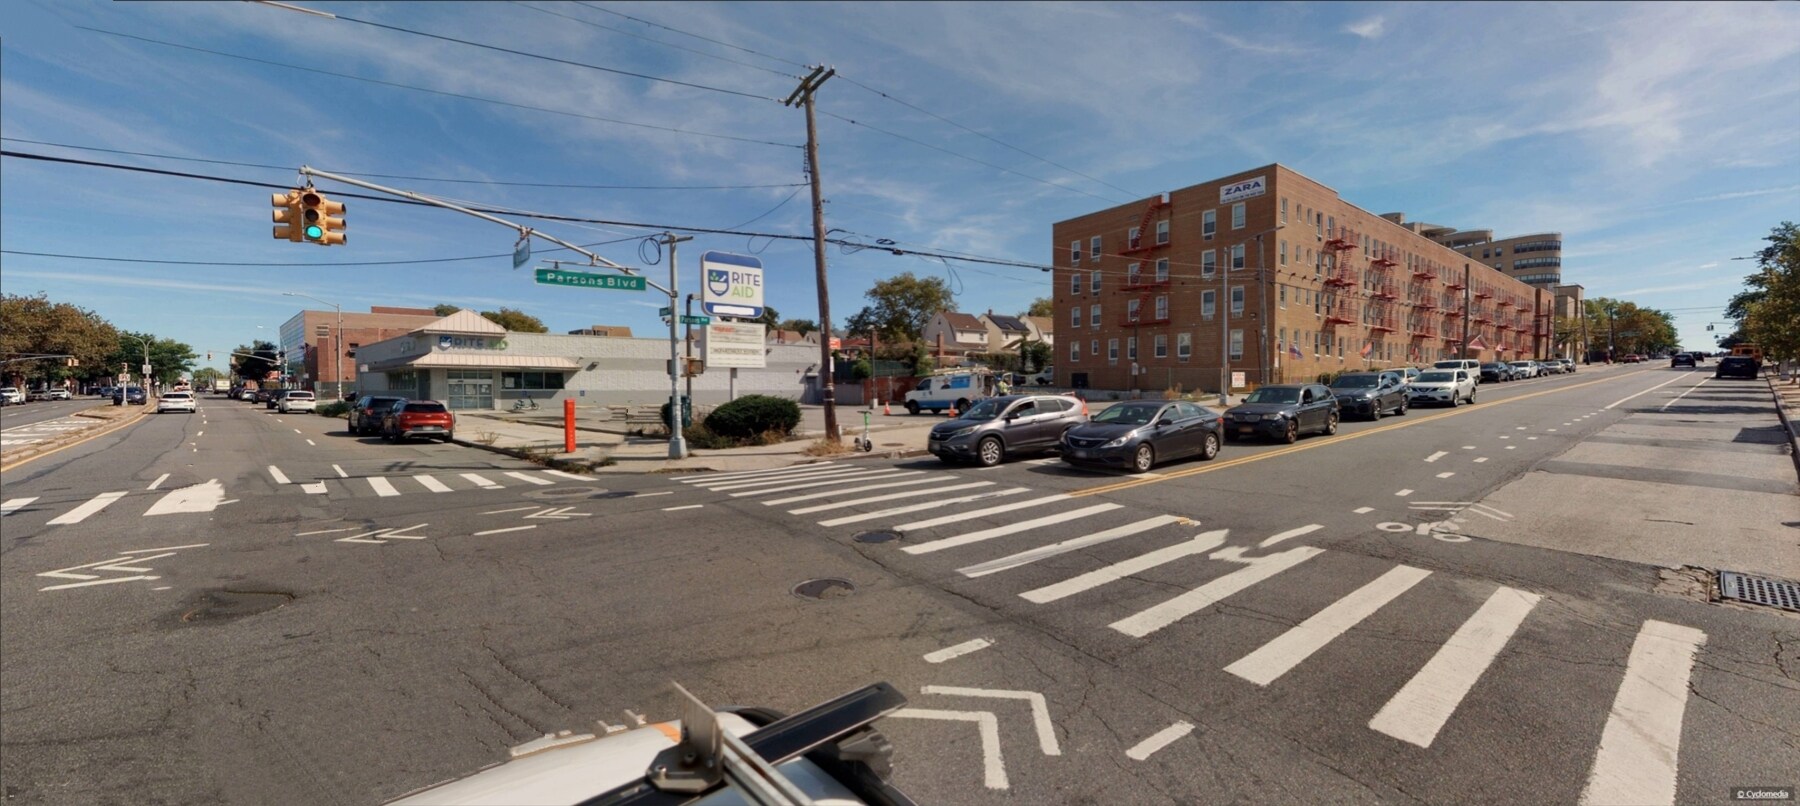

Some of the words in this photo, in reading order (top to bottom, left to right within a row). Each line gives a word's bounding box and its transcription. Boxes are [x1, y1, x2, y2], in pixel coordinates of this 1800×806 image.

[1225, 182, 1261, 195] ZARA
[547, 273, 603, 286] Parsons
[607, 277, 637, 288] Blvd
[732, 272, 760, 286] RITE
[732, 286, 754, 298] AID
[454, 338, 484, 348] RITE
